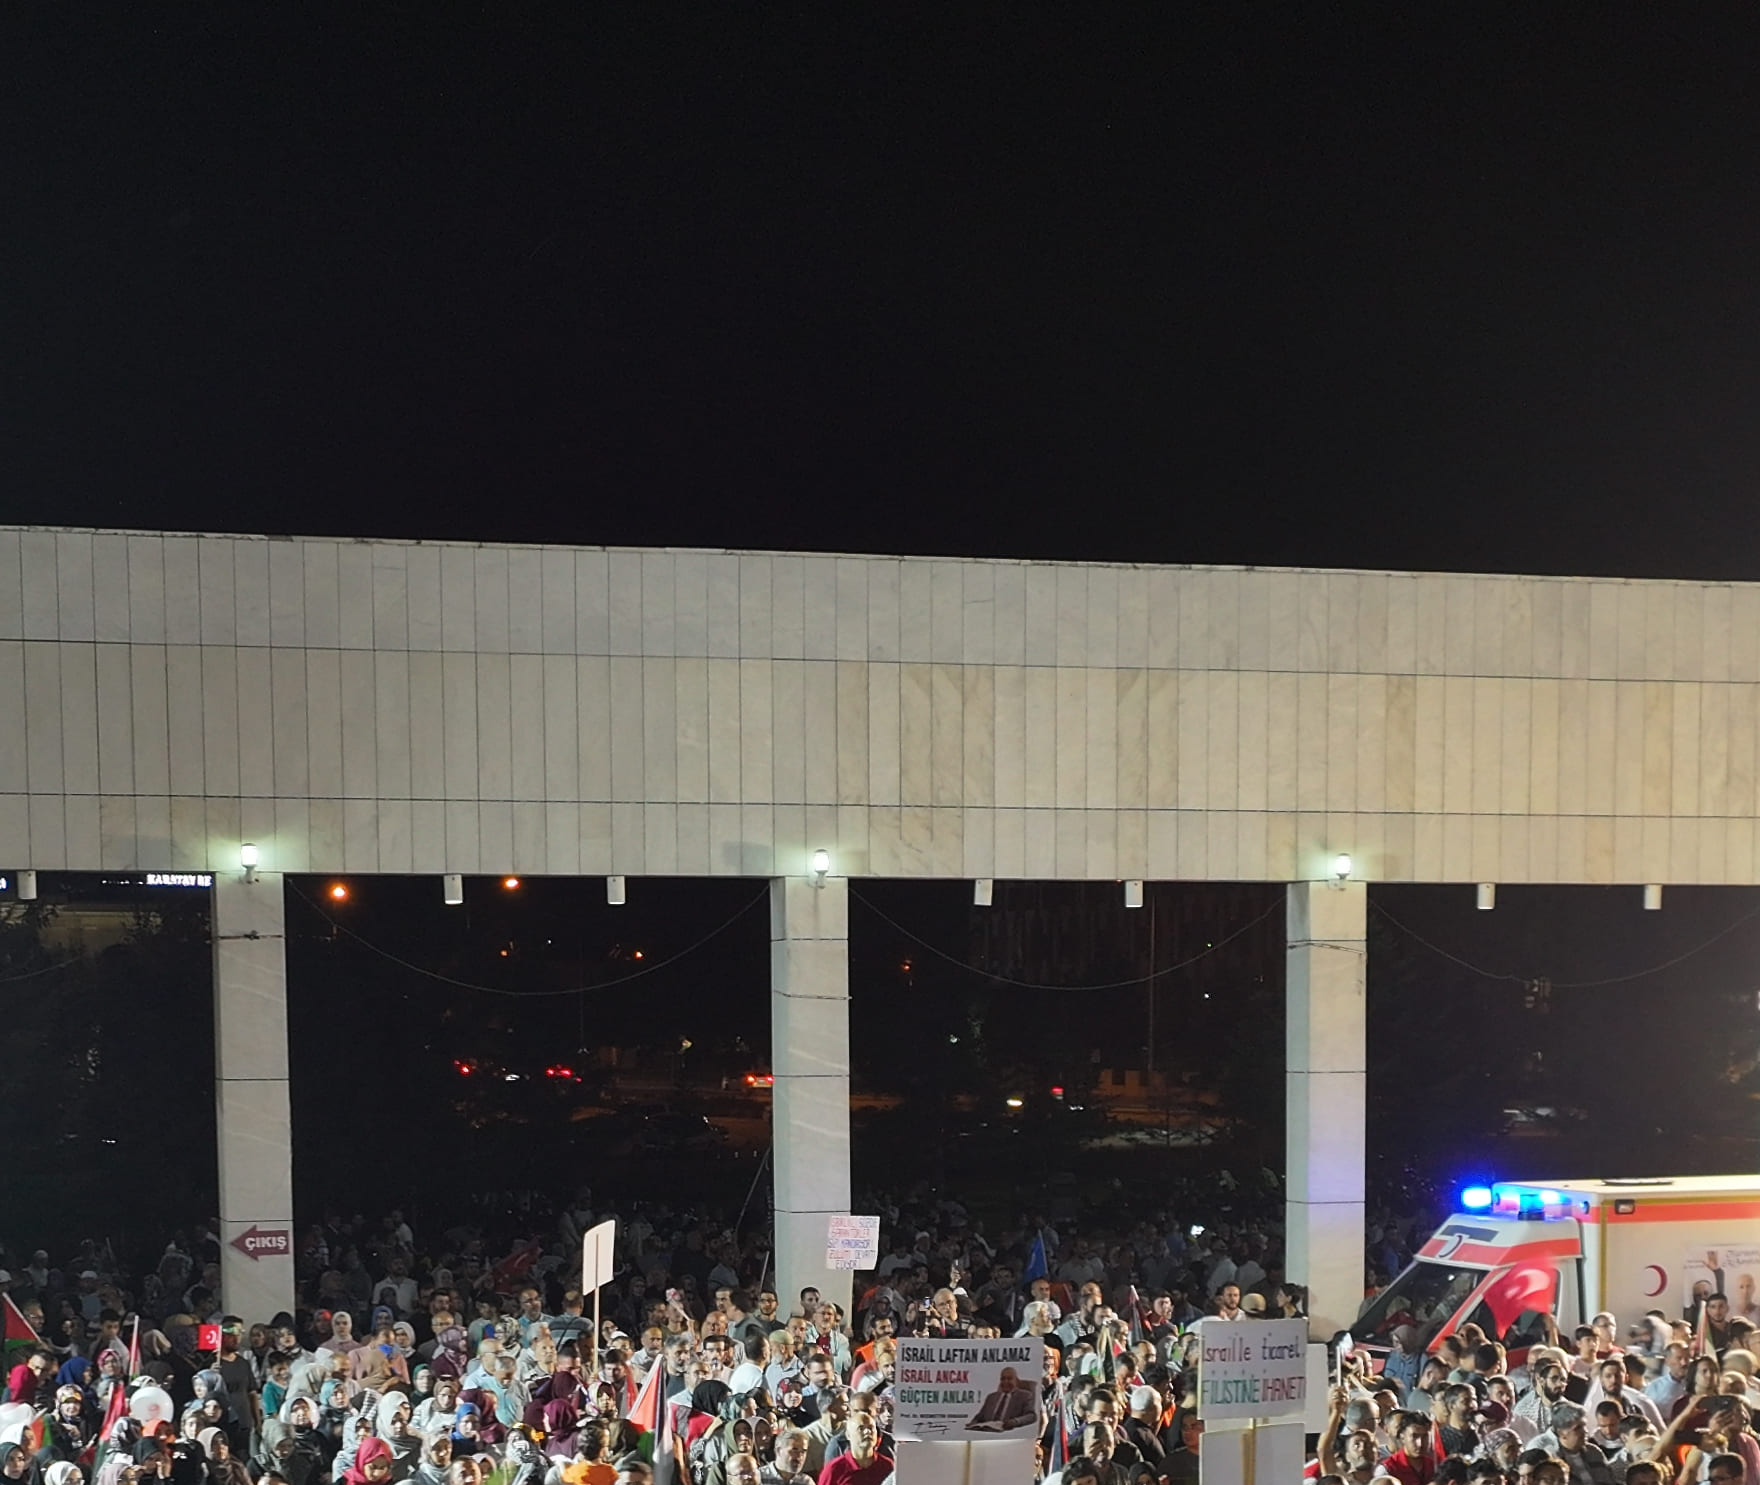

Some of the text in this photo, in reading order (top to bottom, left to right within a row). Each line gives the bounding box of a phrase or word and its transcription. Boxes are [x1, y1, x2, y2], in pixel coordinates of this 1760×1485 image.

[245, 1236, 287, 1251] ÇIKIŞ
[901, 1343, 1031, 1363] İSRAİL LAFTAN ANLAMAZ
[936, 1369, 969, 1384] ANCAK
[900, 1386, 939, 1407] GÜÇTEN
